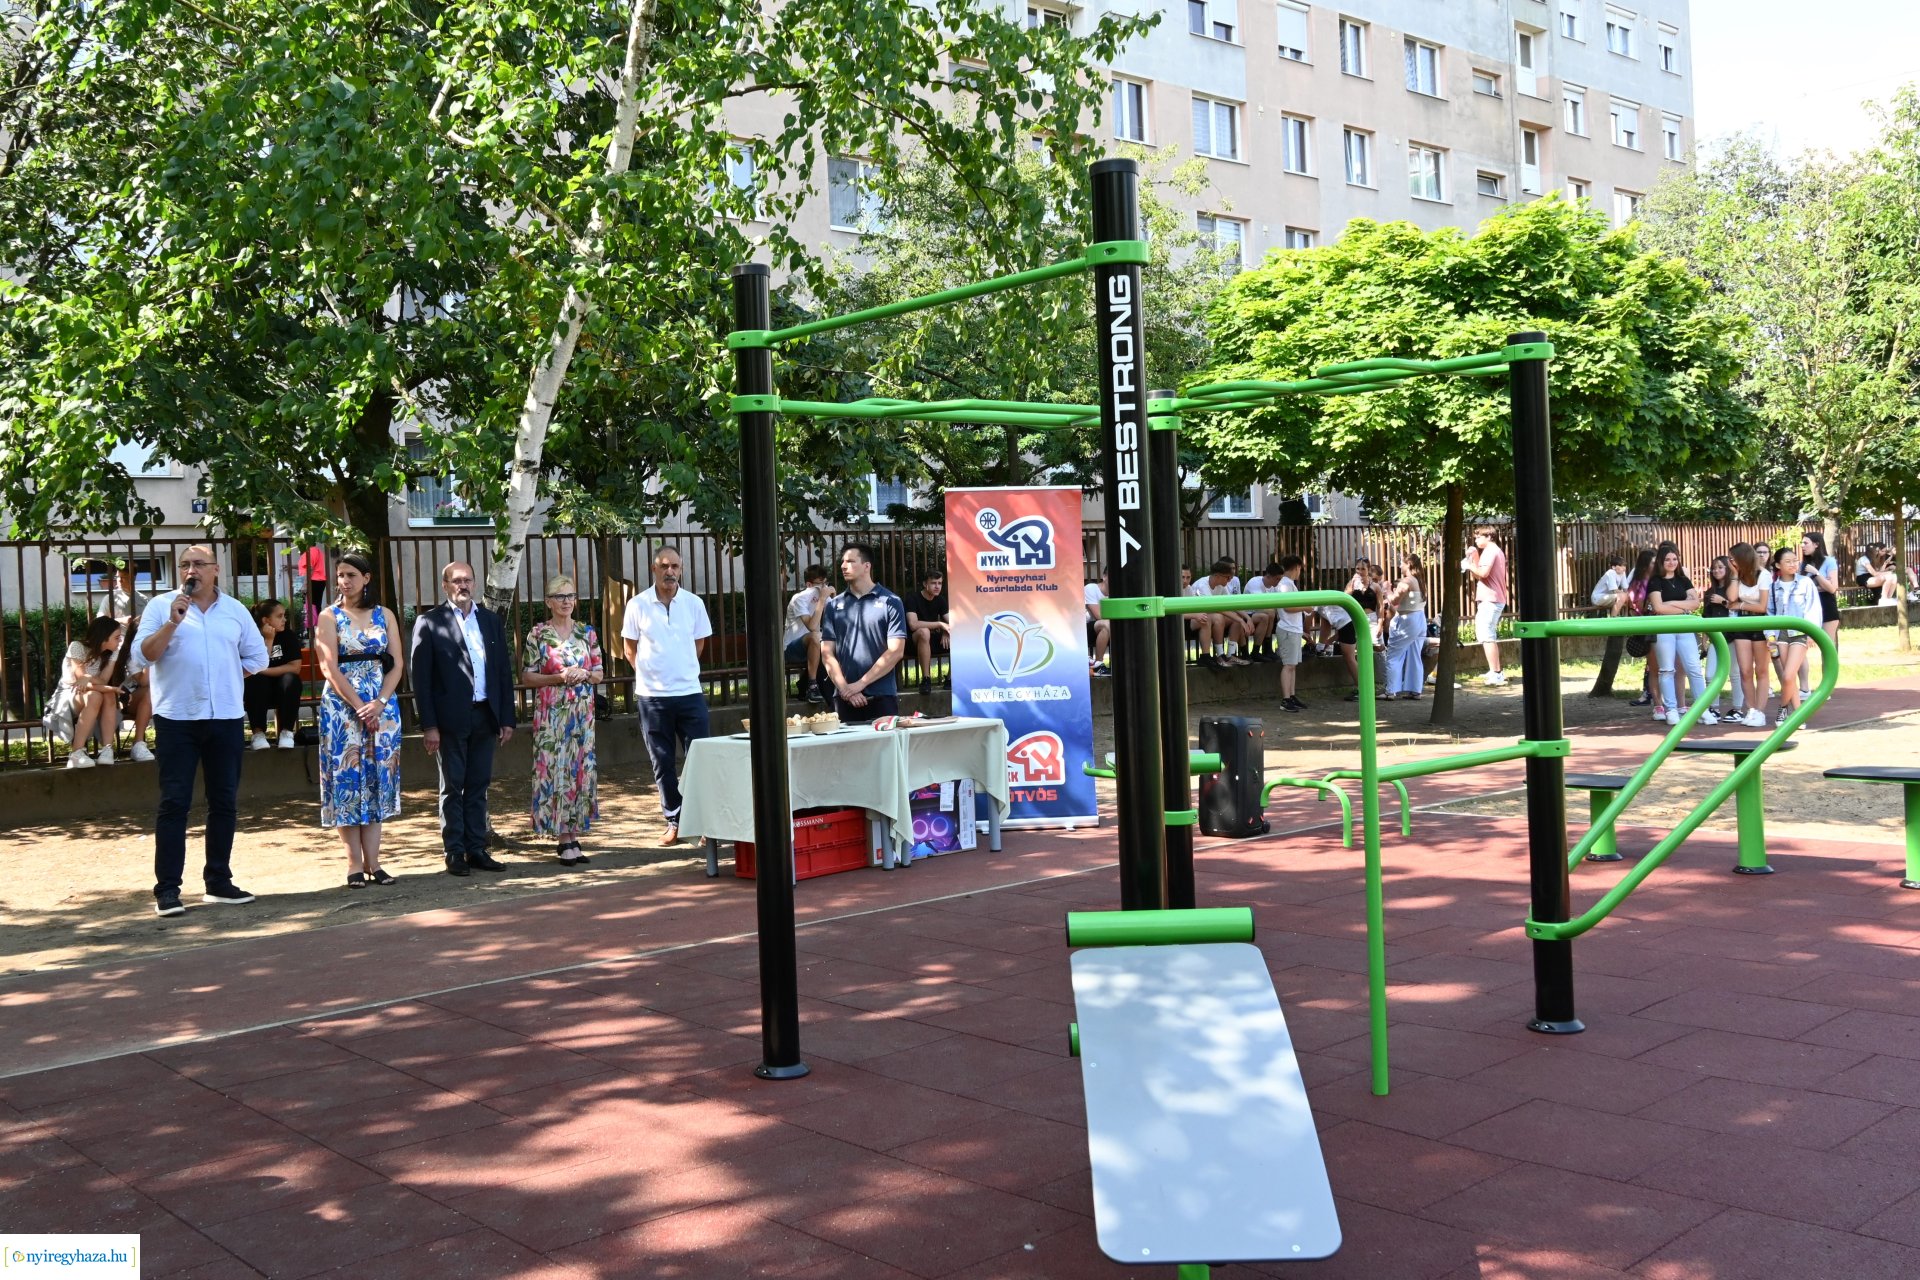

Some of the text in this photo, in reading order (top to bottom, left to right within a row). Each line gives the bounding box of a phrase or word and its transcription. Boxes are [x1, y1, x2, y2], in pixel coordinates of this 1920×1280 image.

[1109, 274, 1140, 510] BESTRONG
[981, 555, 1010, 566] NYKK
[1036, 583, 1058, 591] Klub
[974, 688, 1068, 699] NYÍREGYHÁZA
